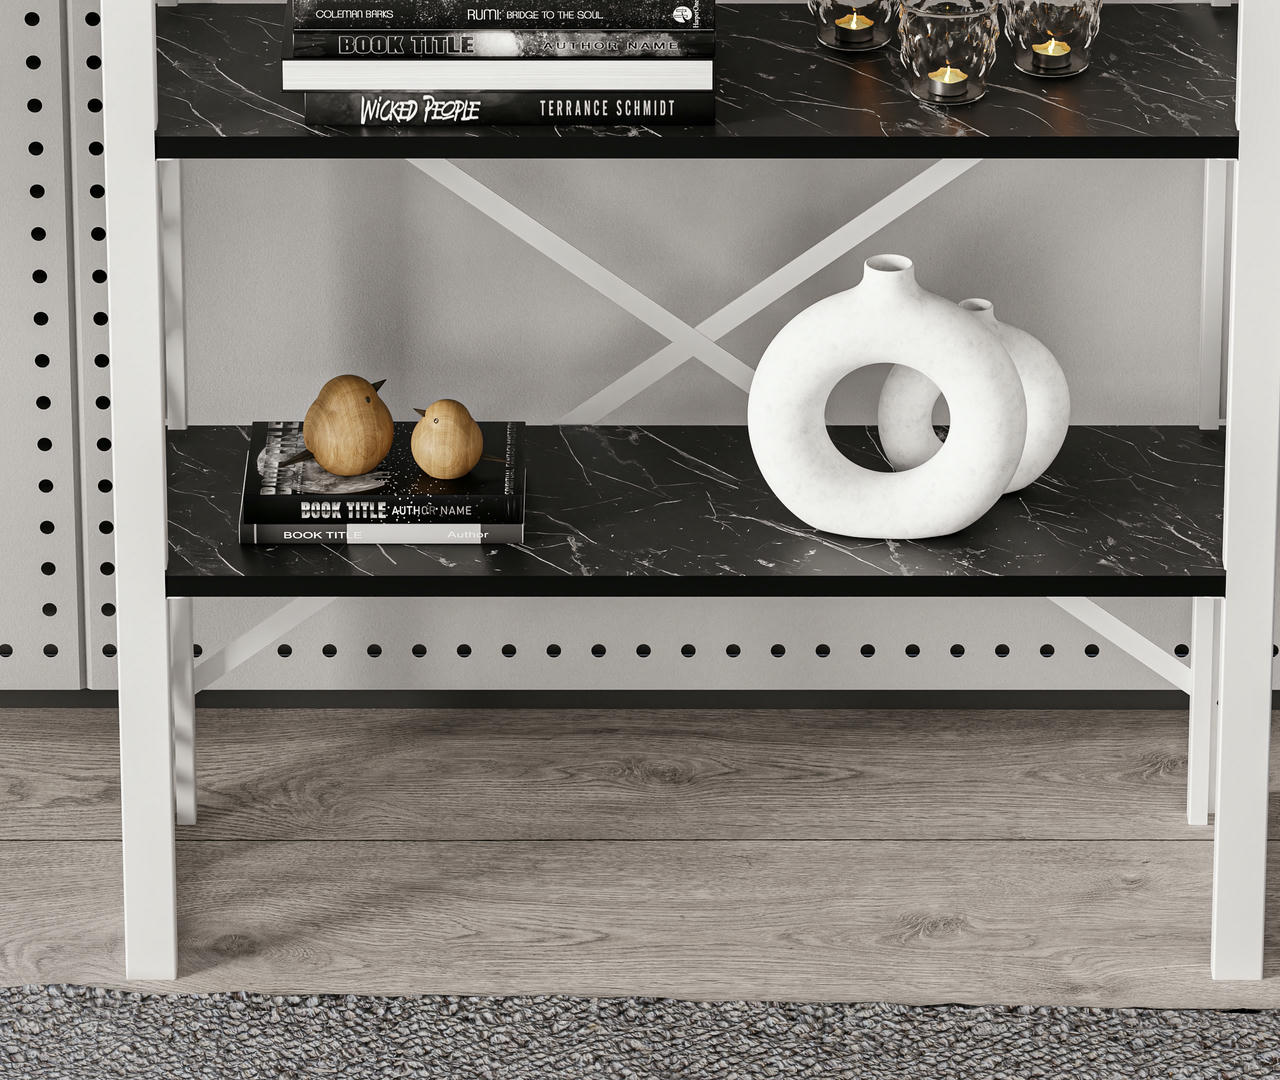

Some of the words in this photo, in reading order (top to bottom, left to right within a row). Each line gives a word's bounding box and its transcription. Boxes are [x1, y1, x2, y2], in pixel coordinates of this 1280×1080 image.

[365, 9, 394, 19] BARKS
[506, 10, 539, 20] BRIDGE
[542, 10, 555, 20] TO
[559, 10, 575, 20] THE
[338, 35, 405, 55] BOOK
[411, 35, 475, 55] TITLE
[543, 41, 619, 51] AUTHOR
[626, 41, 679, 51] NAME
[539, 99, 609, 116] TERRANCE
[616, 99, 675, 116] SCHMIDT
[300, 501, 342, 519] BOOK
[346, 501, 387, 519] TITLE
[391, 505, 437, 516] AUTHOR
[440, 505, 472, 516] NAME
[283, 531, 322, 540] BOOK
[325, 531, 363, 540] TITLE
[447, 530, 489, 539] Author
